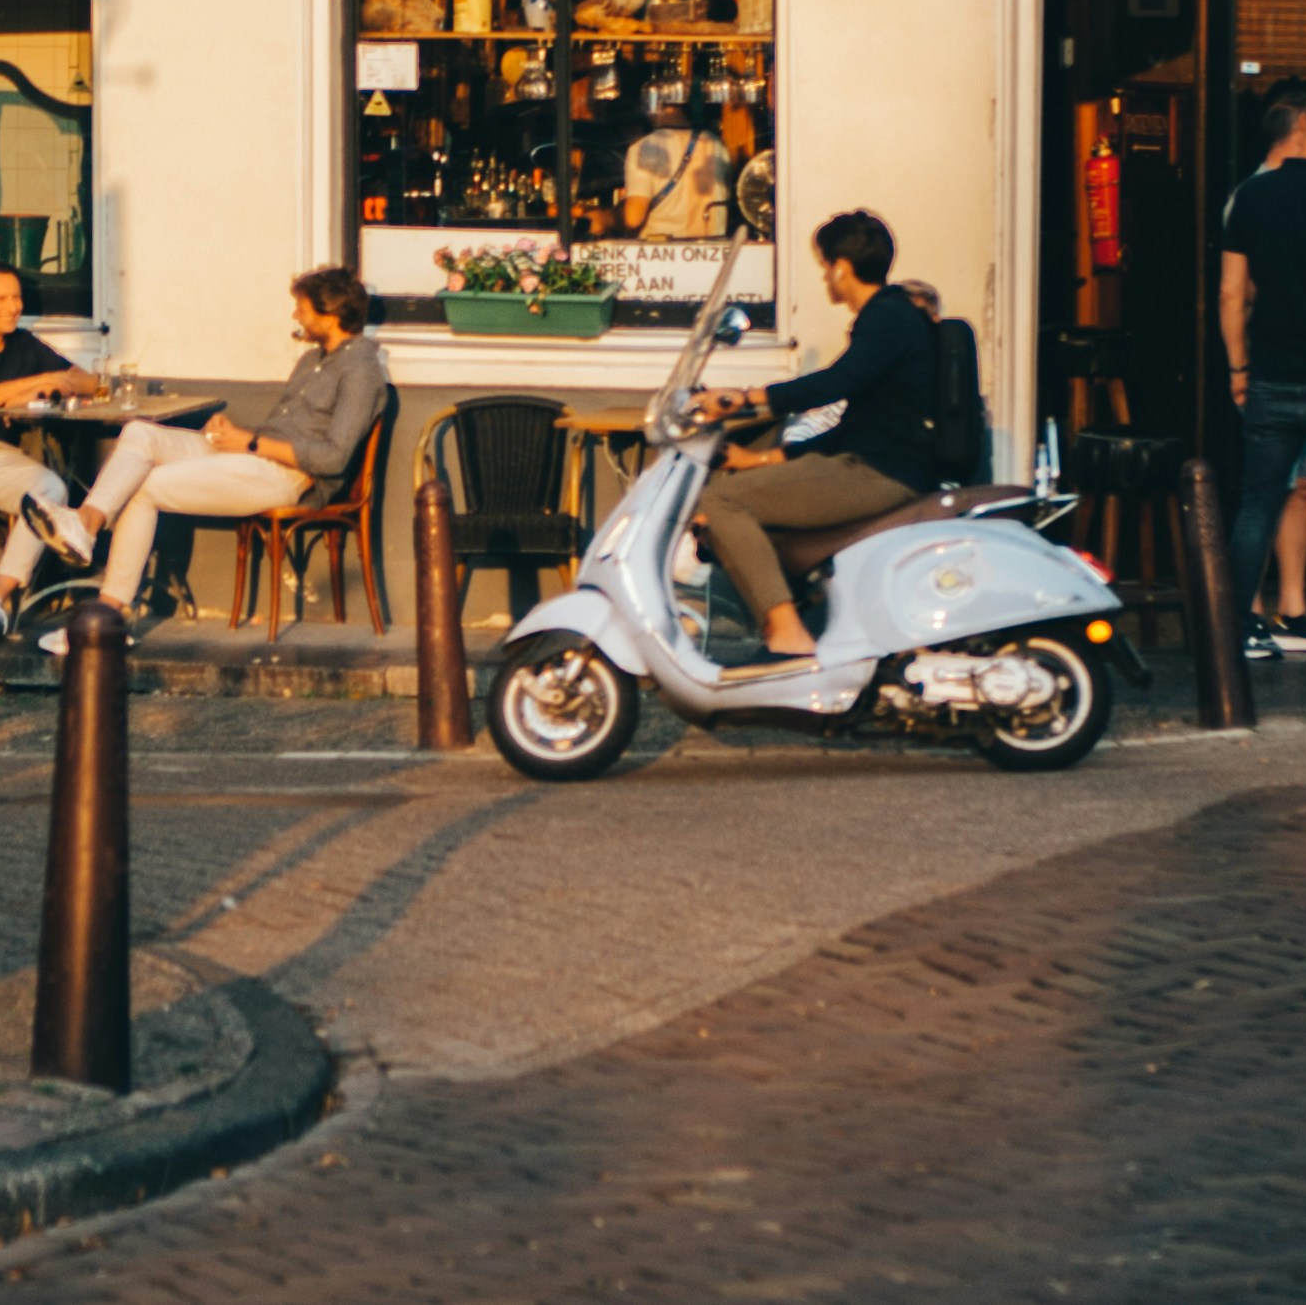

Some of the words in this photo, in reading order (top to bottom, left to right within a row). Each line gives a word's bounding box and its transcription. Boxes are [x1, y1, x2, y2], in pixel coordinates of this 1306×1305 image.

[637, 246, 676, 262] AAN
[681, 246, 731, 262] ONZE
[635, 277, 675, 291] AAN
